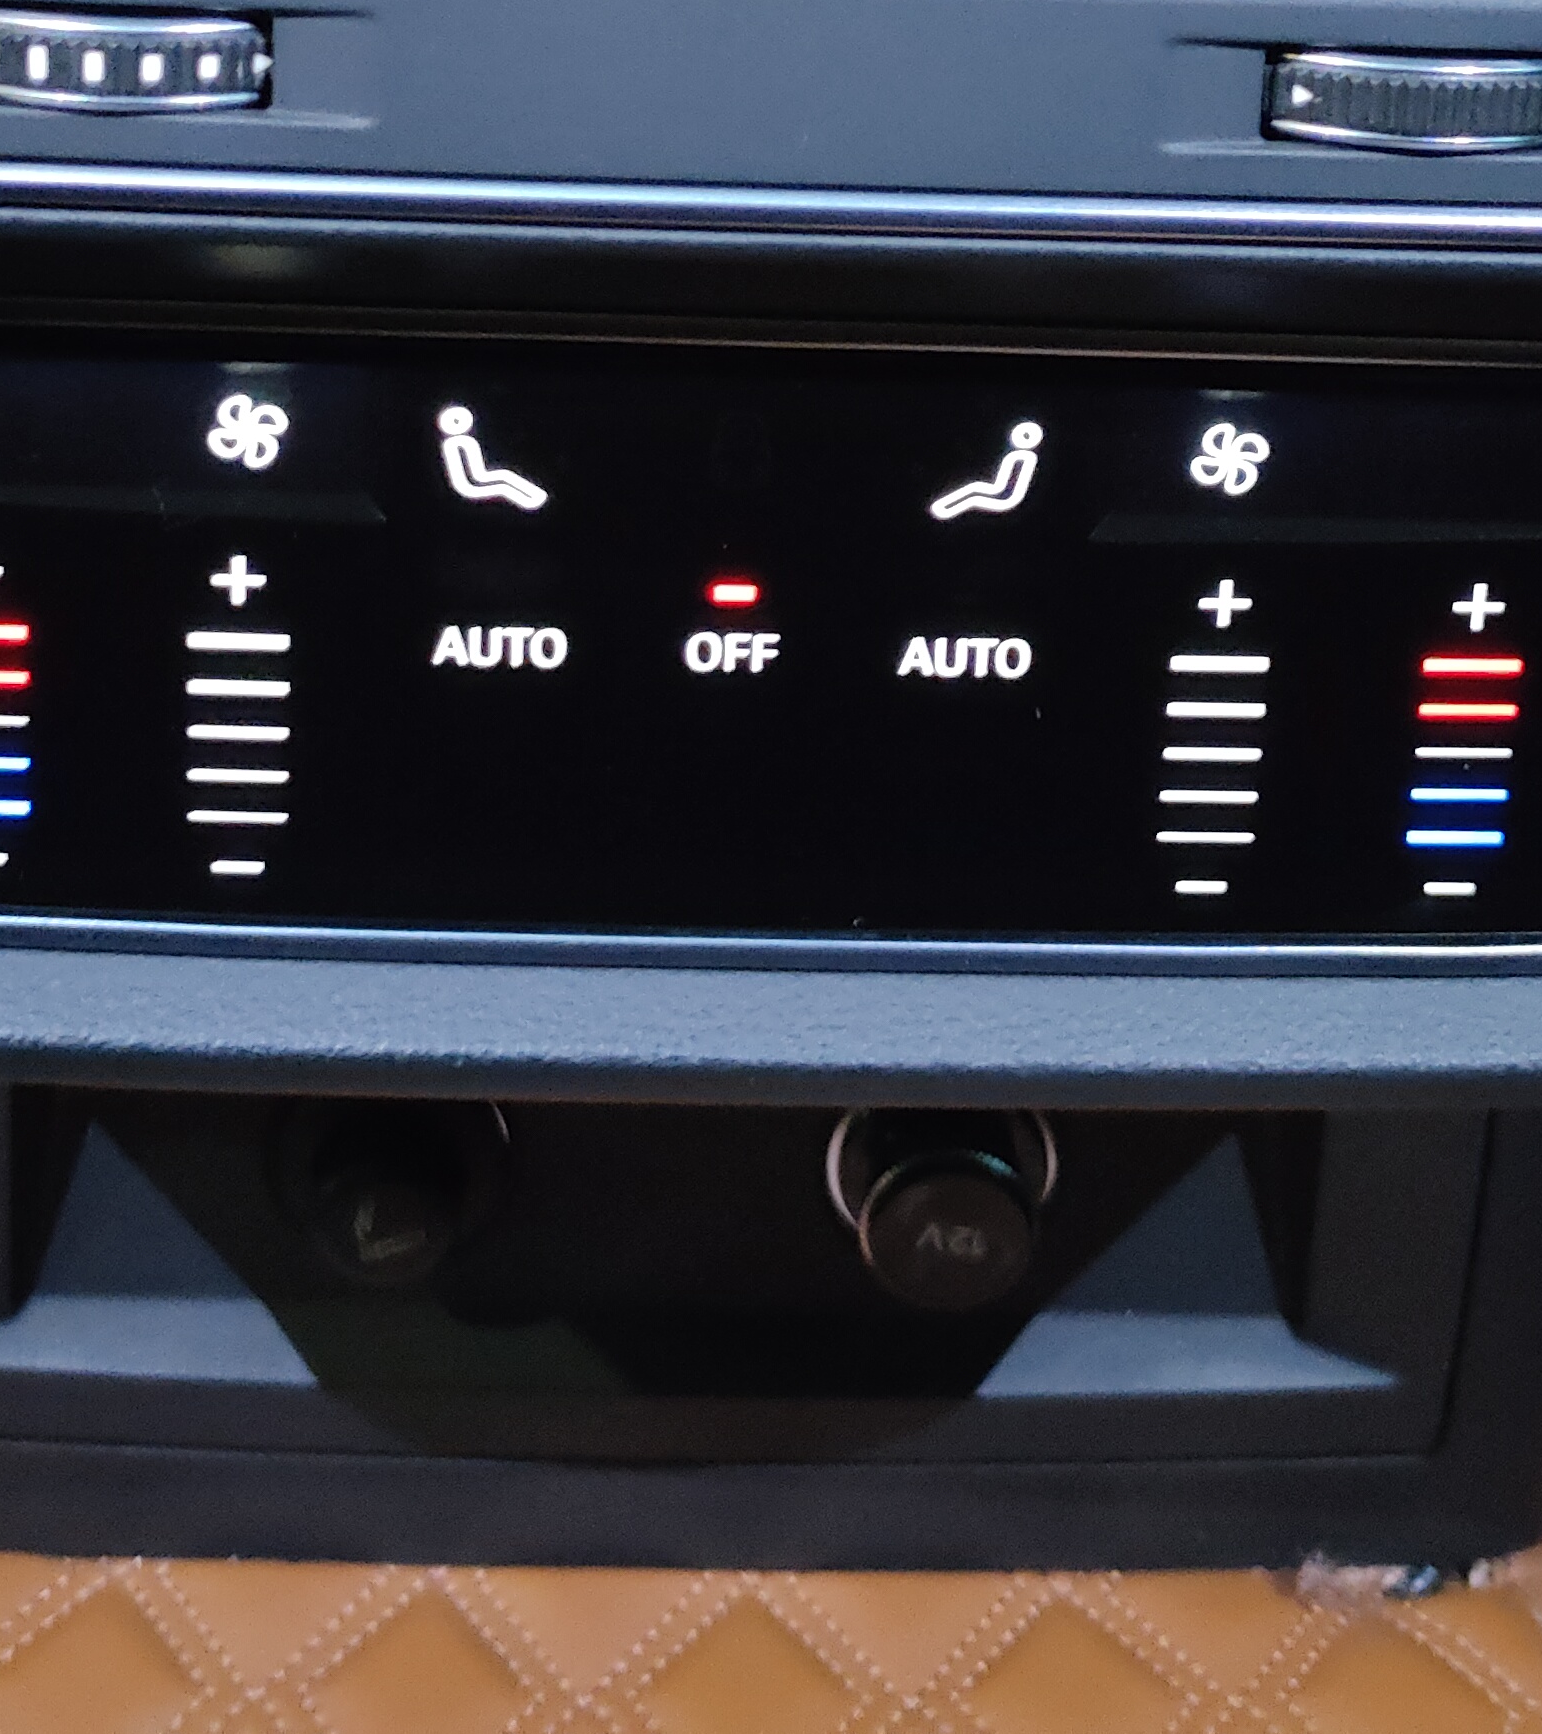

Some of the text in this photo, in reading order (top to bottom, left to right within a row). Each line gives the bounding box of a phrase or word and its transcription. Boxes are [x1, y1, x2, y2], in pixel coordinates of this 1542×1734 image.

[430, 624, 568, 669] AUTO
[684, 630, 781, 674] OFF
[896, 635, 1032, 680] AUTO
